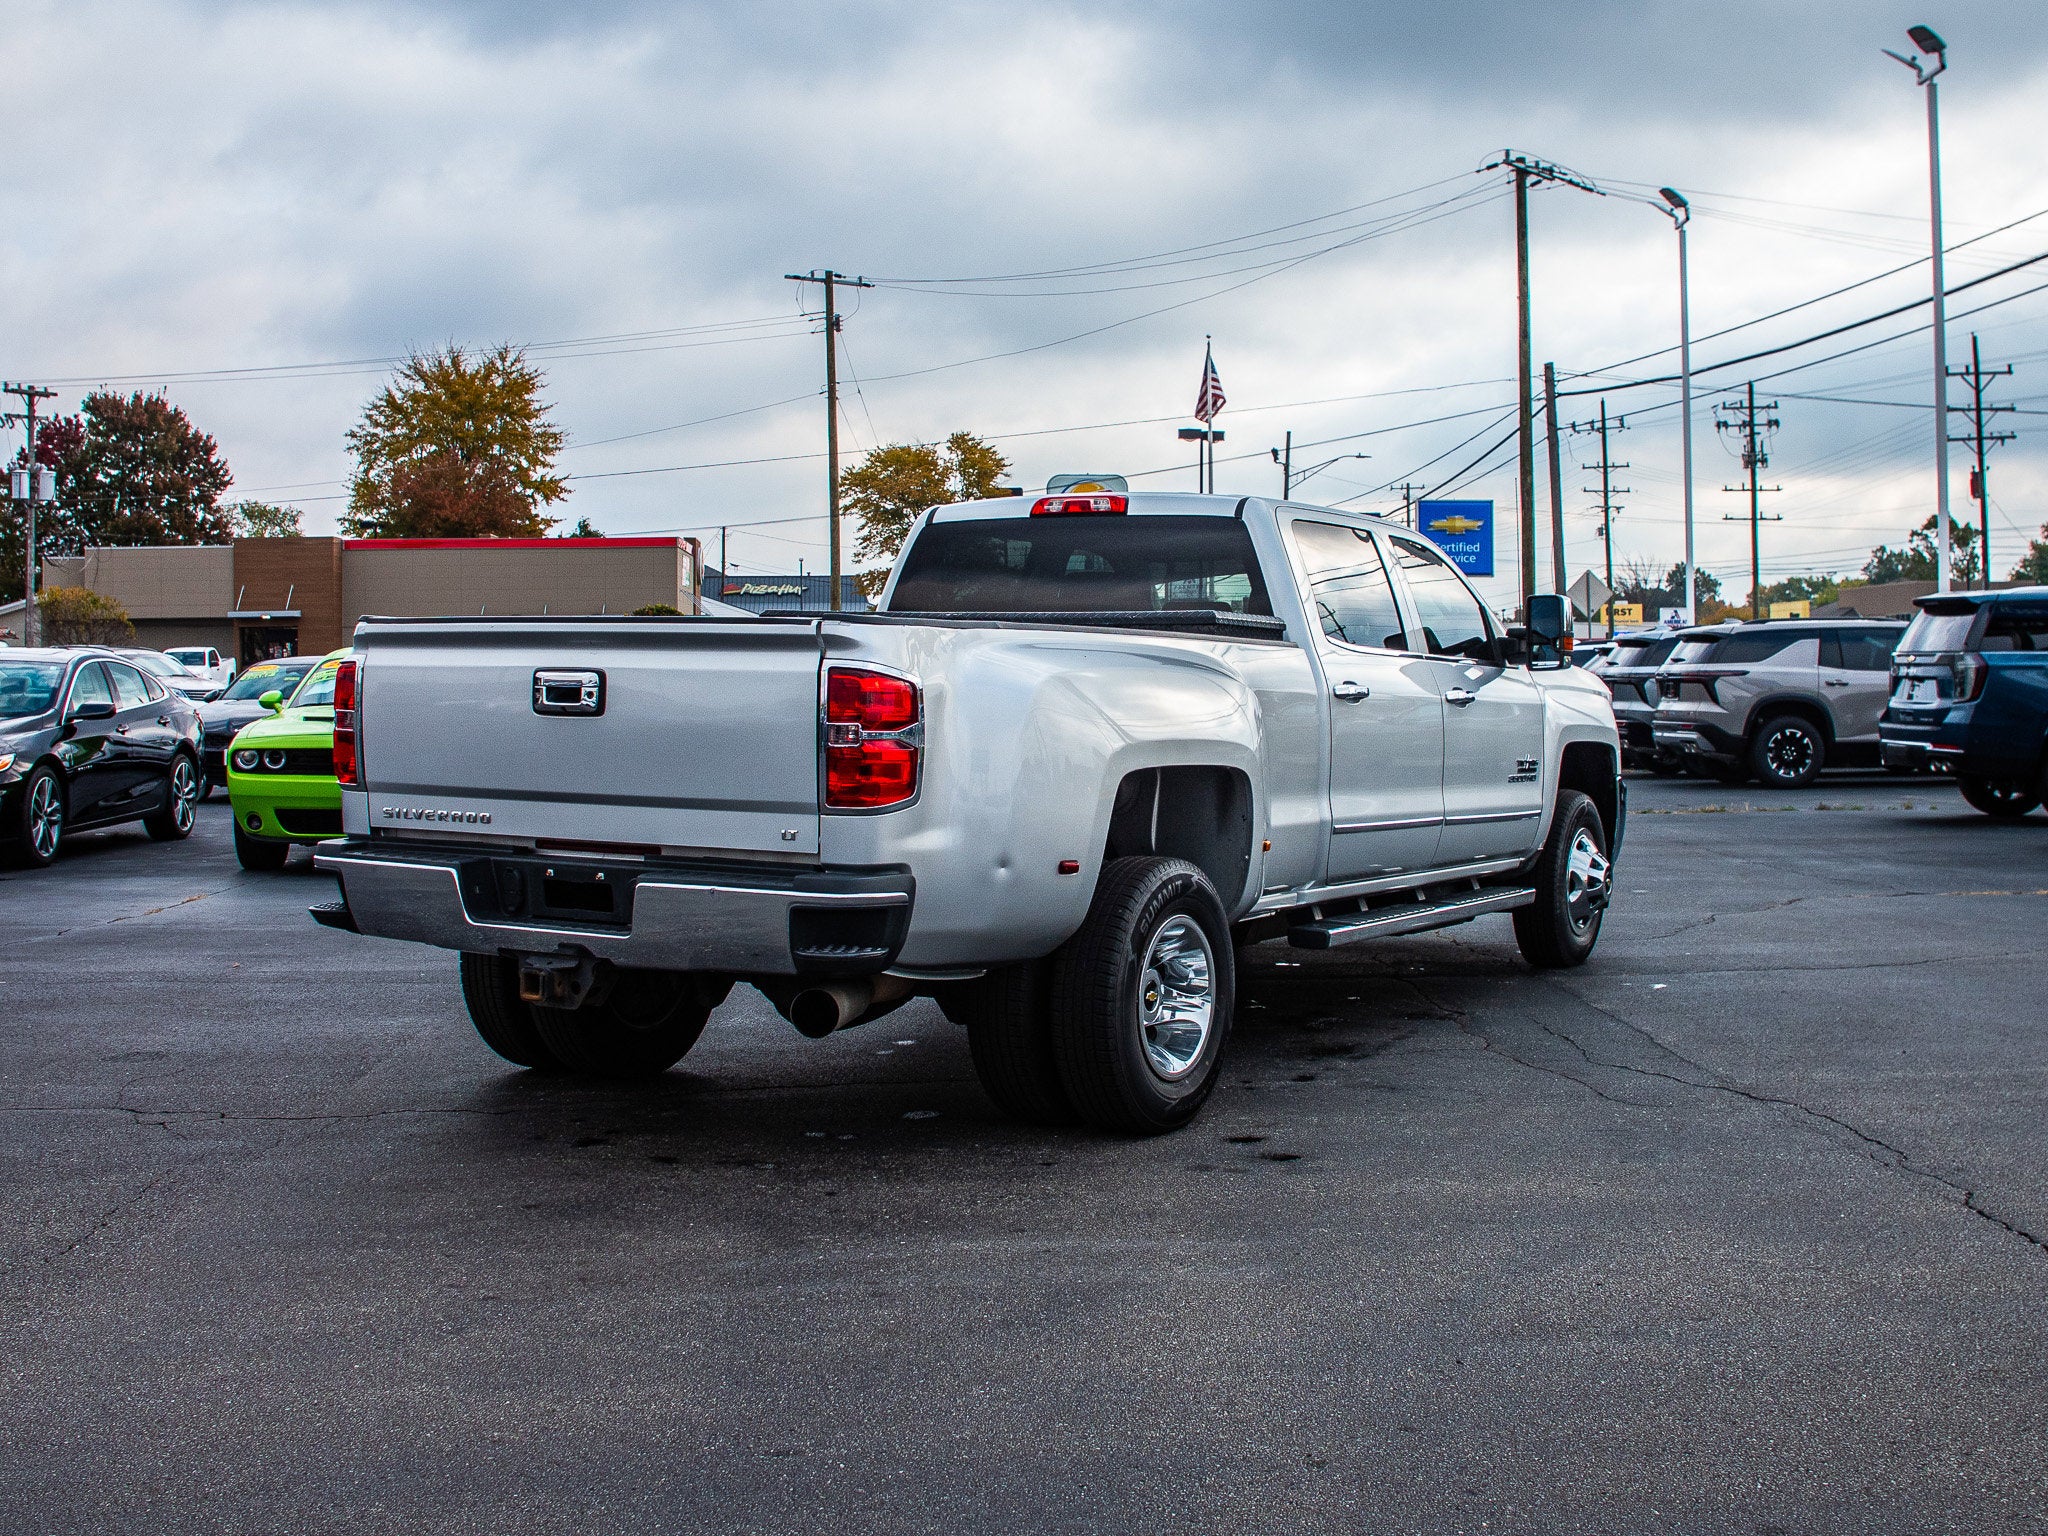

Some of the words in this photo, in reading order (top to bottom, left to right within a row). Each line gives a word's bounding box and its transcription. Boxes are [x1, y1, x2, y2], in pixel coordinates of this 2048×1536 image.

[1436, 542, 1480, 552] ertified
[1450, 553, 1476, 563] rvice
[740, 583, 778, 595] Pizza
[778, 584, 808, 595] Hut
[1606, 608, 1633, 616] RST
[382, 806, 492, 825] SILVERADO
[781, 829, 799, 841] LT
[1140, 879, 1183, 935] SUMMIT
